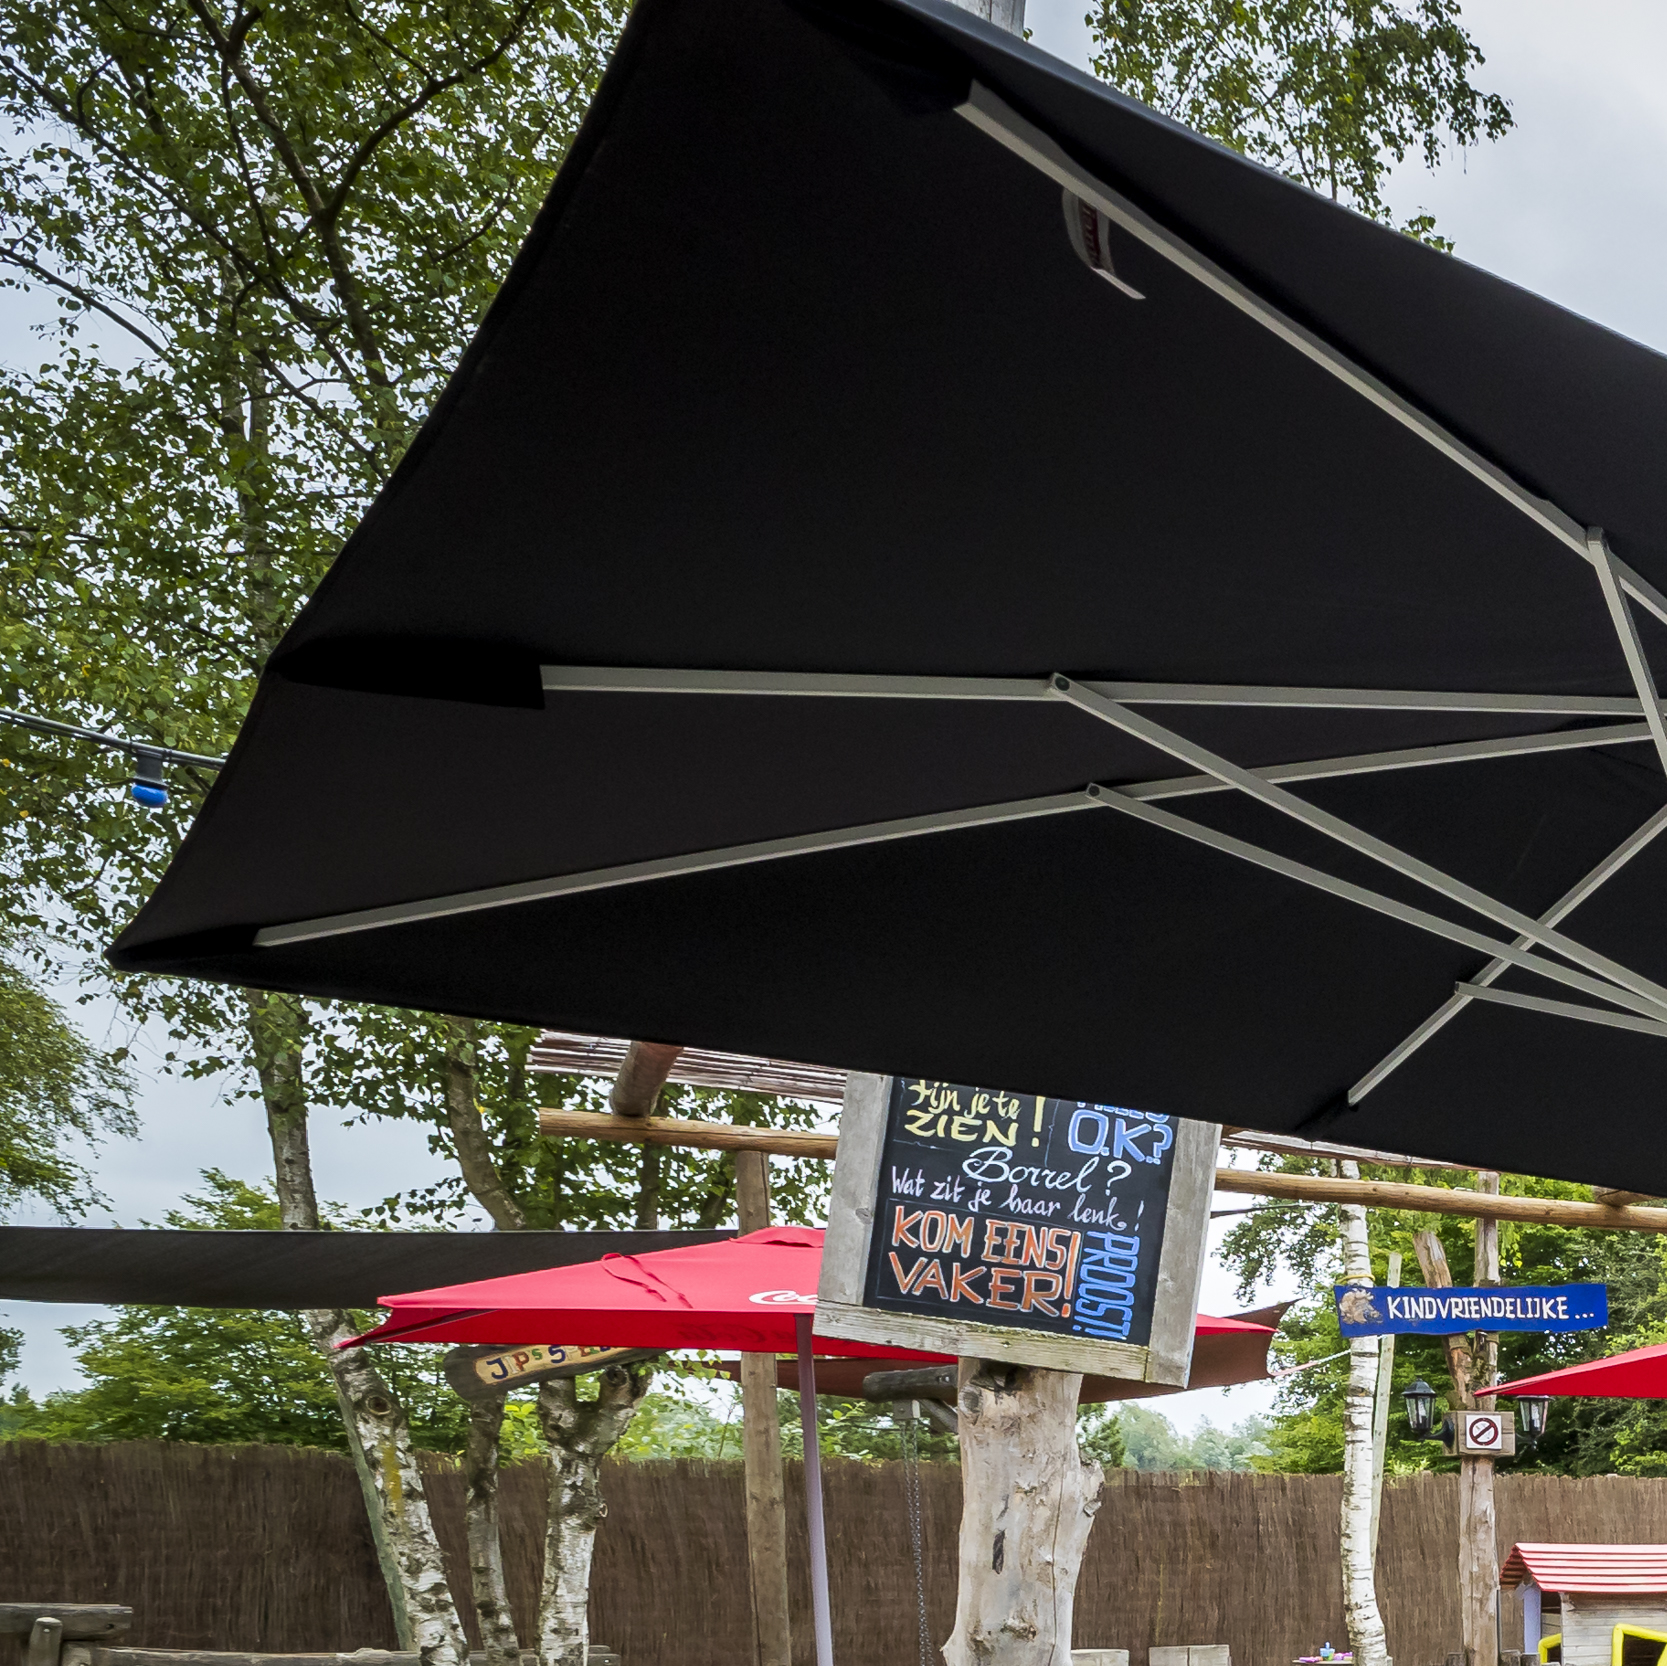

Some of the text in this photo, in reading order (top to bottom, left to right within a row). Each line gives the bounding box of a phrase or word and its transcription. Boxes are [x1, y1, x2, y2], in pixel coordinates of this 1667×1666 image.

[891, 1165, 926, 1197] Wat
[930, 1174, 966, 1203] zit
[967, 1182, 992, 1212] je
[892, 1205, 1072, 1271] KOM EENS
[1386, 1296, 1570, 1320] KINDVRIENDELIJKE
